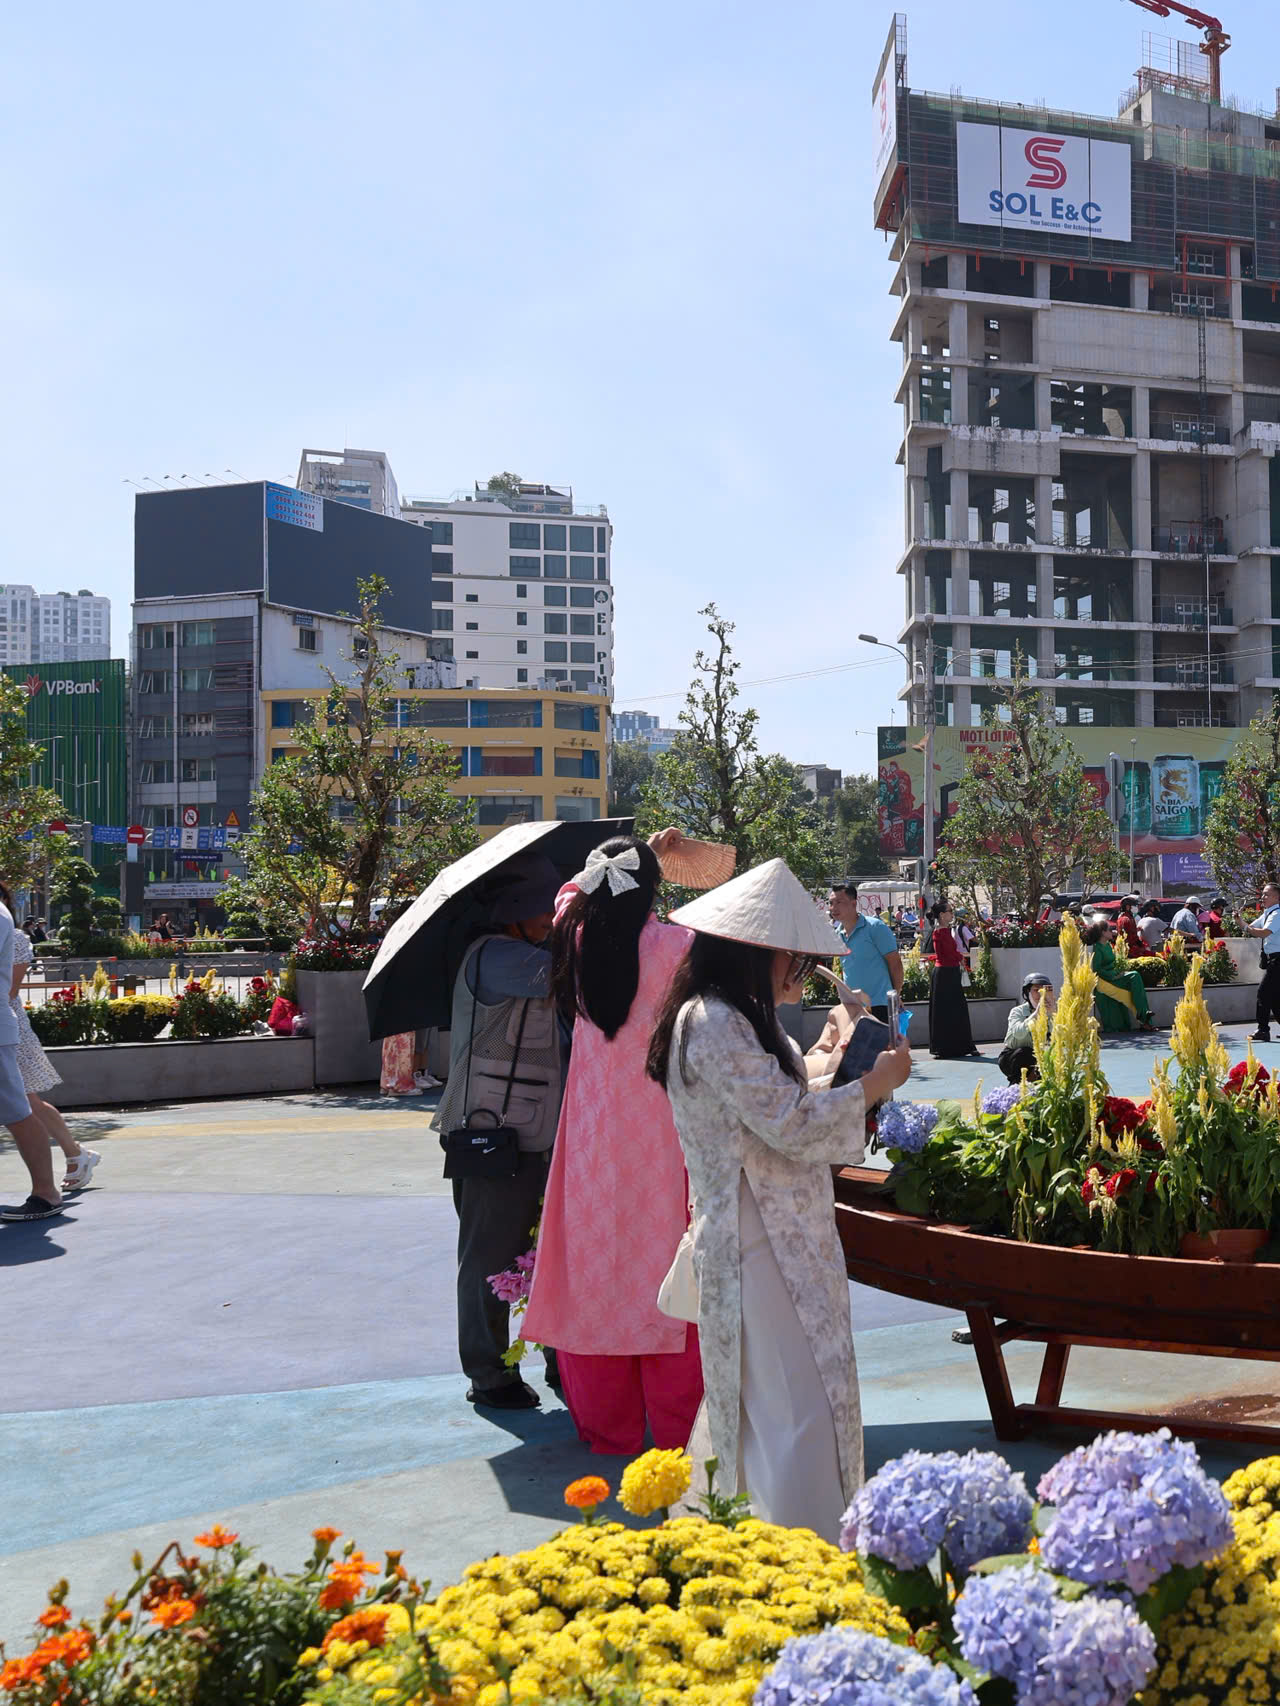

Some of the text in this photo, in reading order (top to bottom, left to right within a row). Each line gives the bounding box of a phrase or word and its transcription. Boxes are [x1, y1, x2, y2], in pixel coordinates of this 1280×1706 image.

[989, 190, 1102, 224] SOL E&C
[46, 678, 103, 695] VPBank
[1154, 805, 1195, 815] SAIGON
